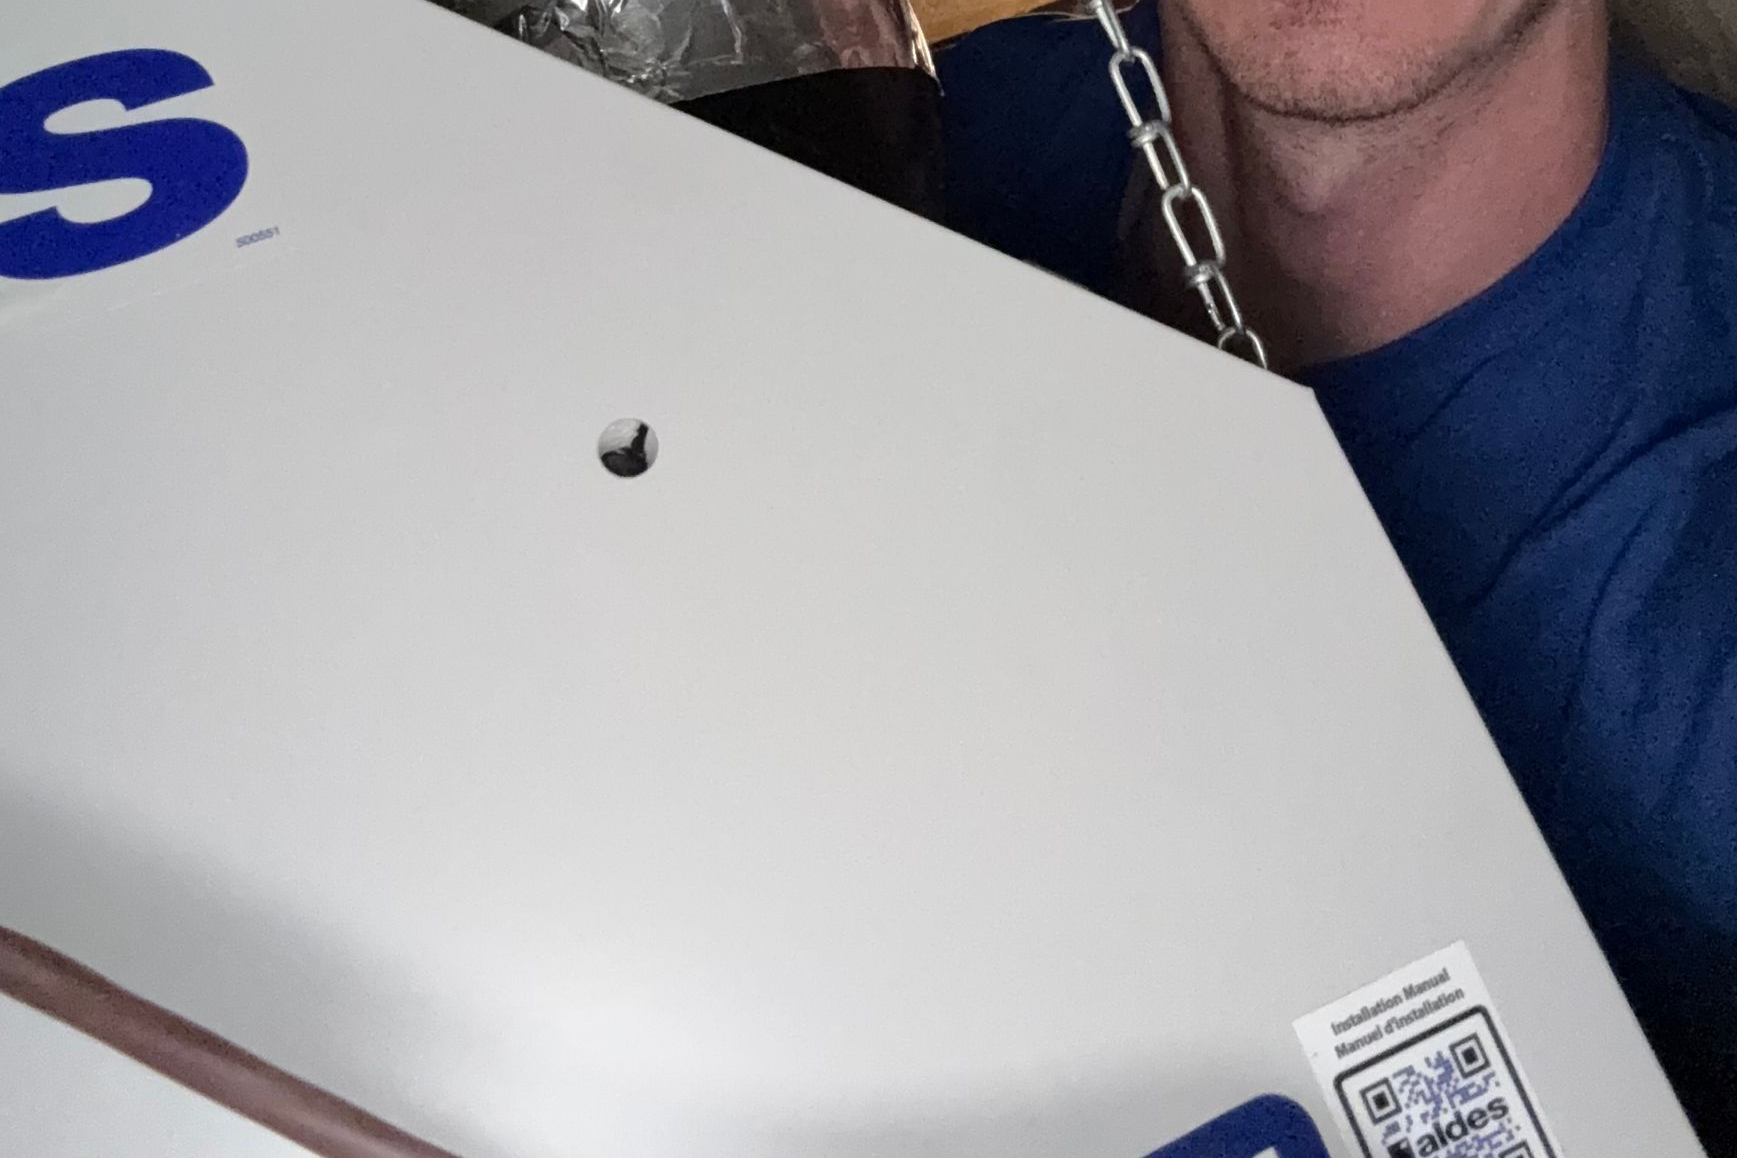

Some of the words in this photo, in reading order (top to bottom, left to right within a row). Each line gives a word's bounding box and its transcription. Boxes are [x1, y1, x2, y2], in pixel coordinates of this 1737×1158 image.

[1331, 995, 1403, 1036] Installation
[1402, 967, 1451, 1001] Manual
[1334, 1023, 1384, 1060] Manuel
[1383, 987, 1466, 1035] d'installation
[1417, 1096, 1511, 1157] aldes
